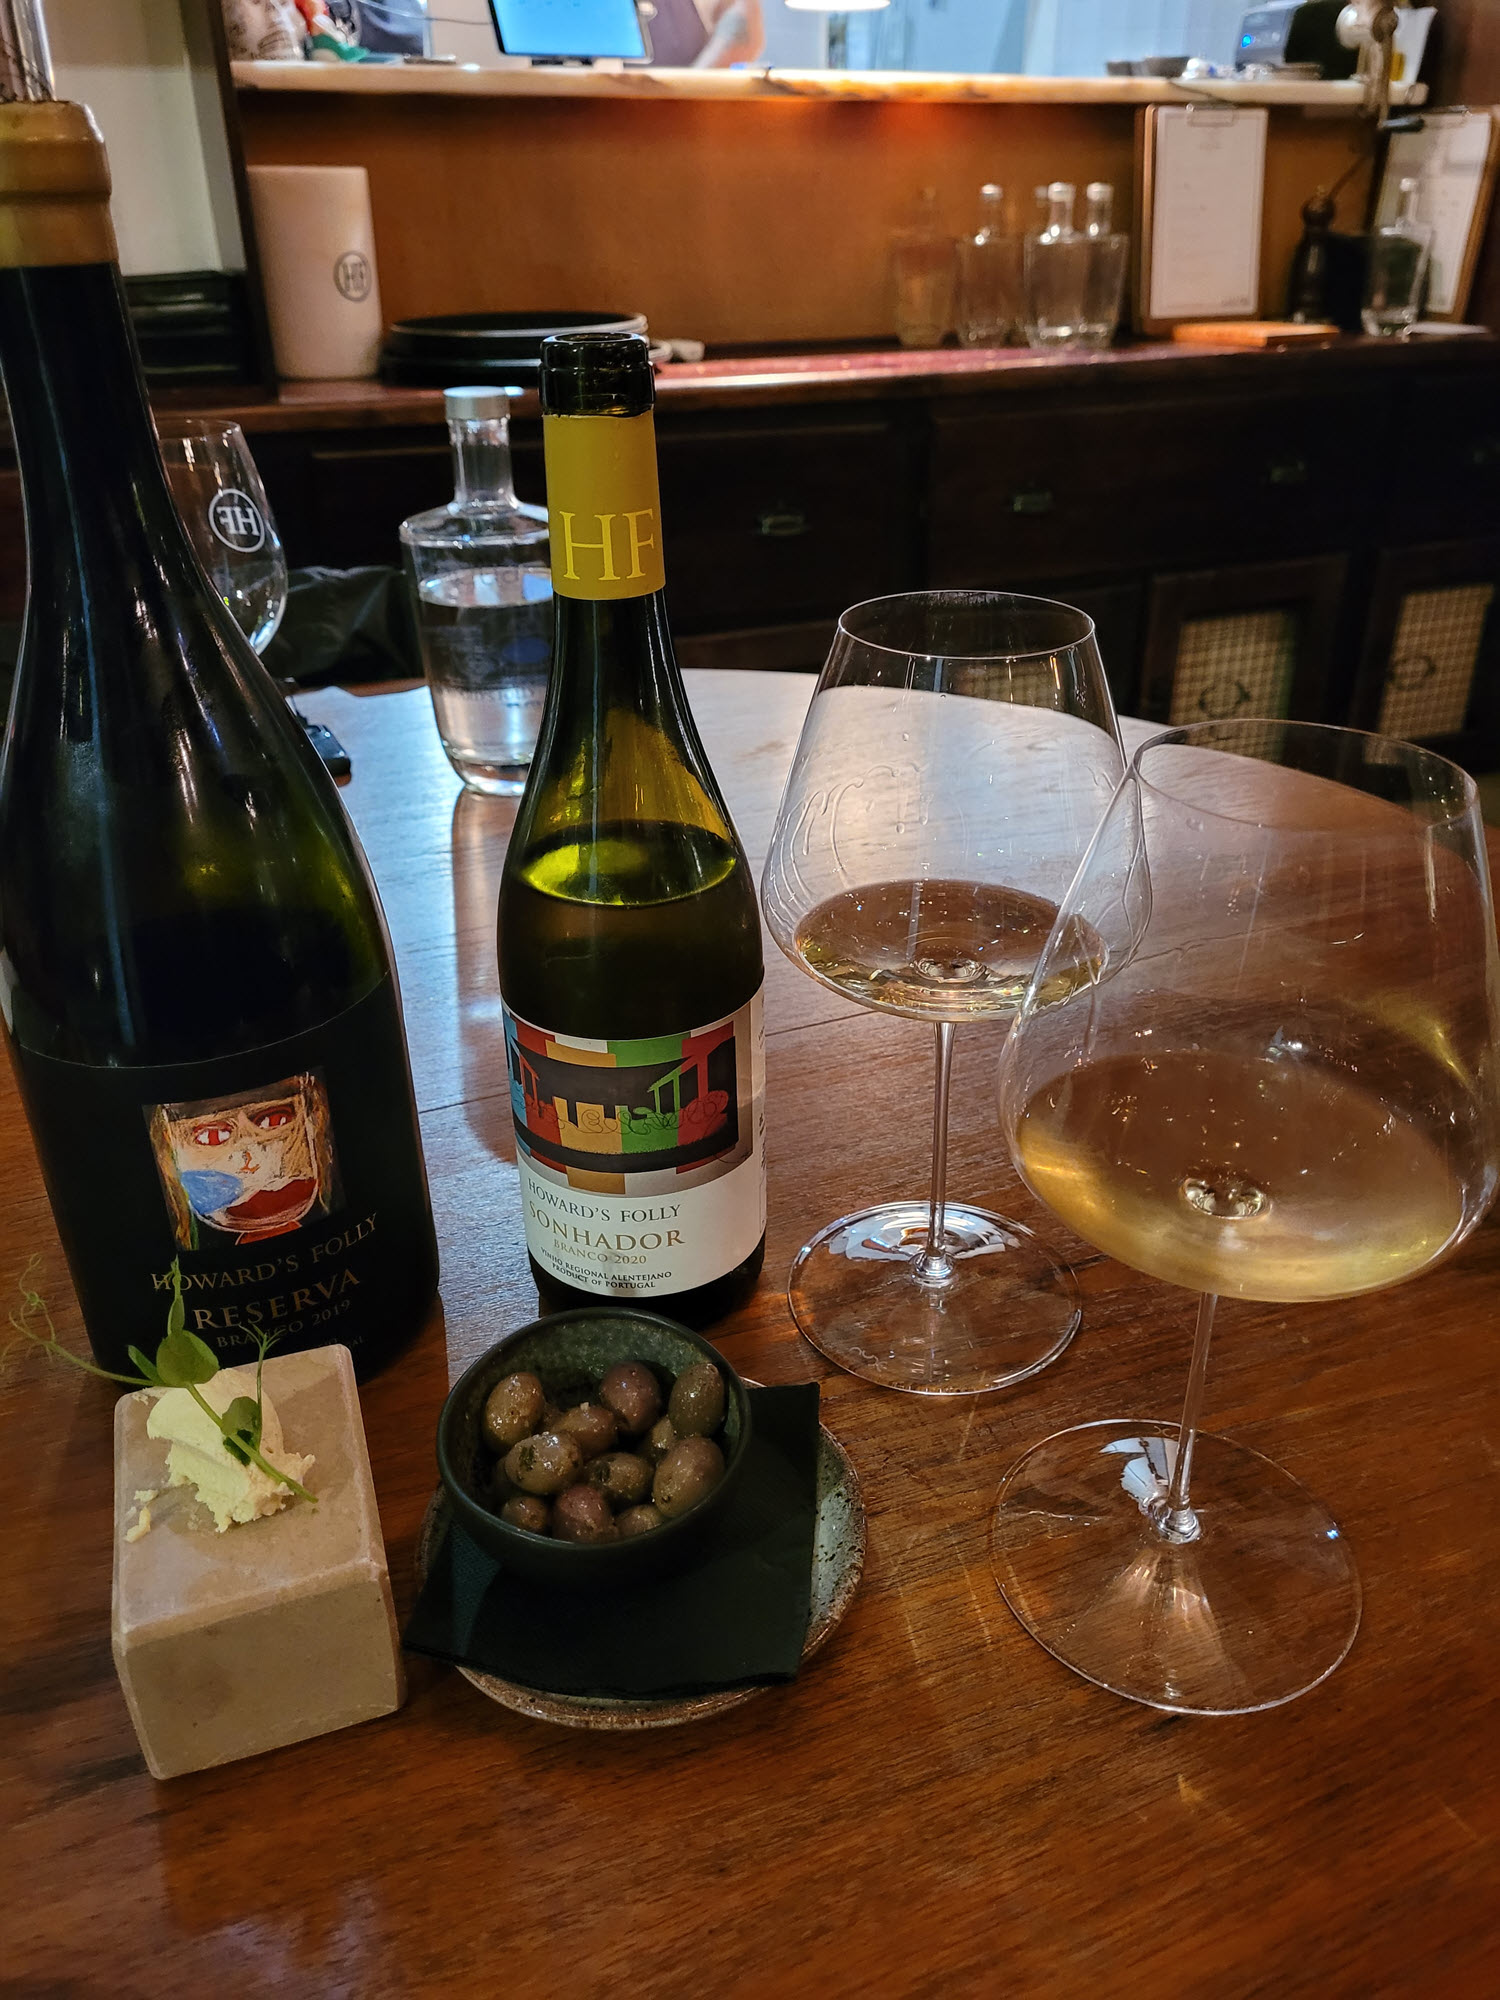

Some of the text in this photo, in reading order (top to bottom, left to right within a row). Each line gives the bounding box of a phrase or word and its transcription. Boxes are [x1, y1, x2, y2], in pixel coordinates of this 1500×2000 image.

[559, 508, 655, 580] HF
[527, 1177, 681, 1222] HOWARD'S FOLLY
[529, 1200, 686, 1251] SONHADOR
[151, 1212, 377, 1291] HOWARD'S FOLLY
[540, 1247, 672, 1282] VINHO REGIONAL ALENTEJANO
[553, 1238, 647, 1264] BRANCO 2020
[552, 1263, 588, 1283] PRODUCT
[605, 1281, 656, 1289] PORTUGAL
[192, 1268, 361, 1330] RESERVA
[312, 1300, 351, 1326] 2019
